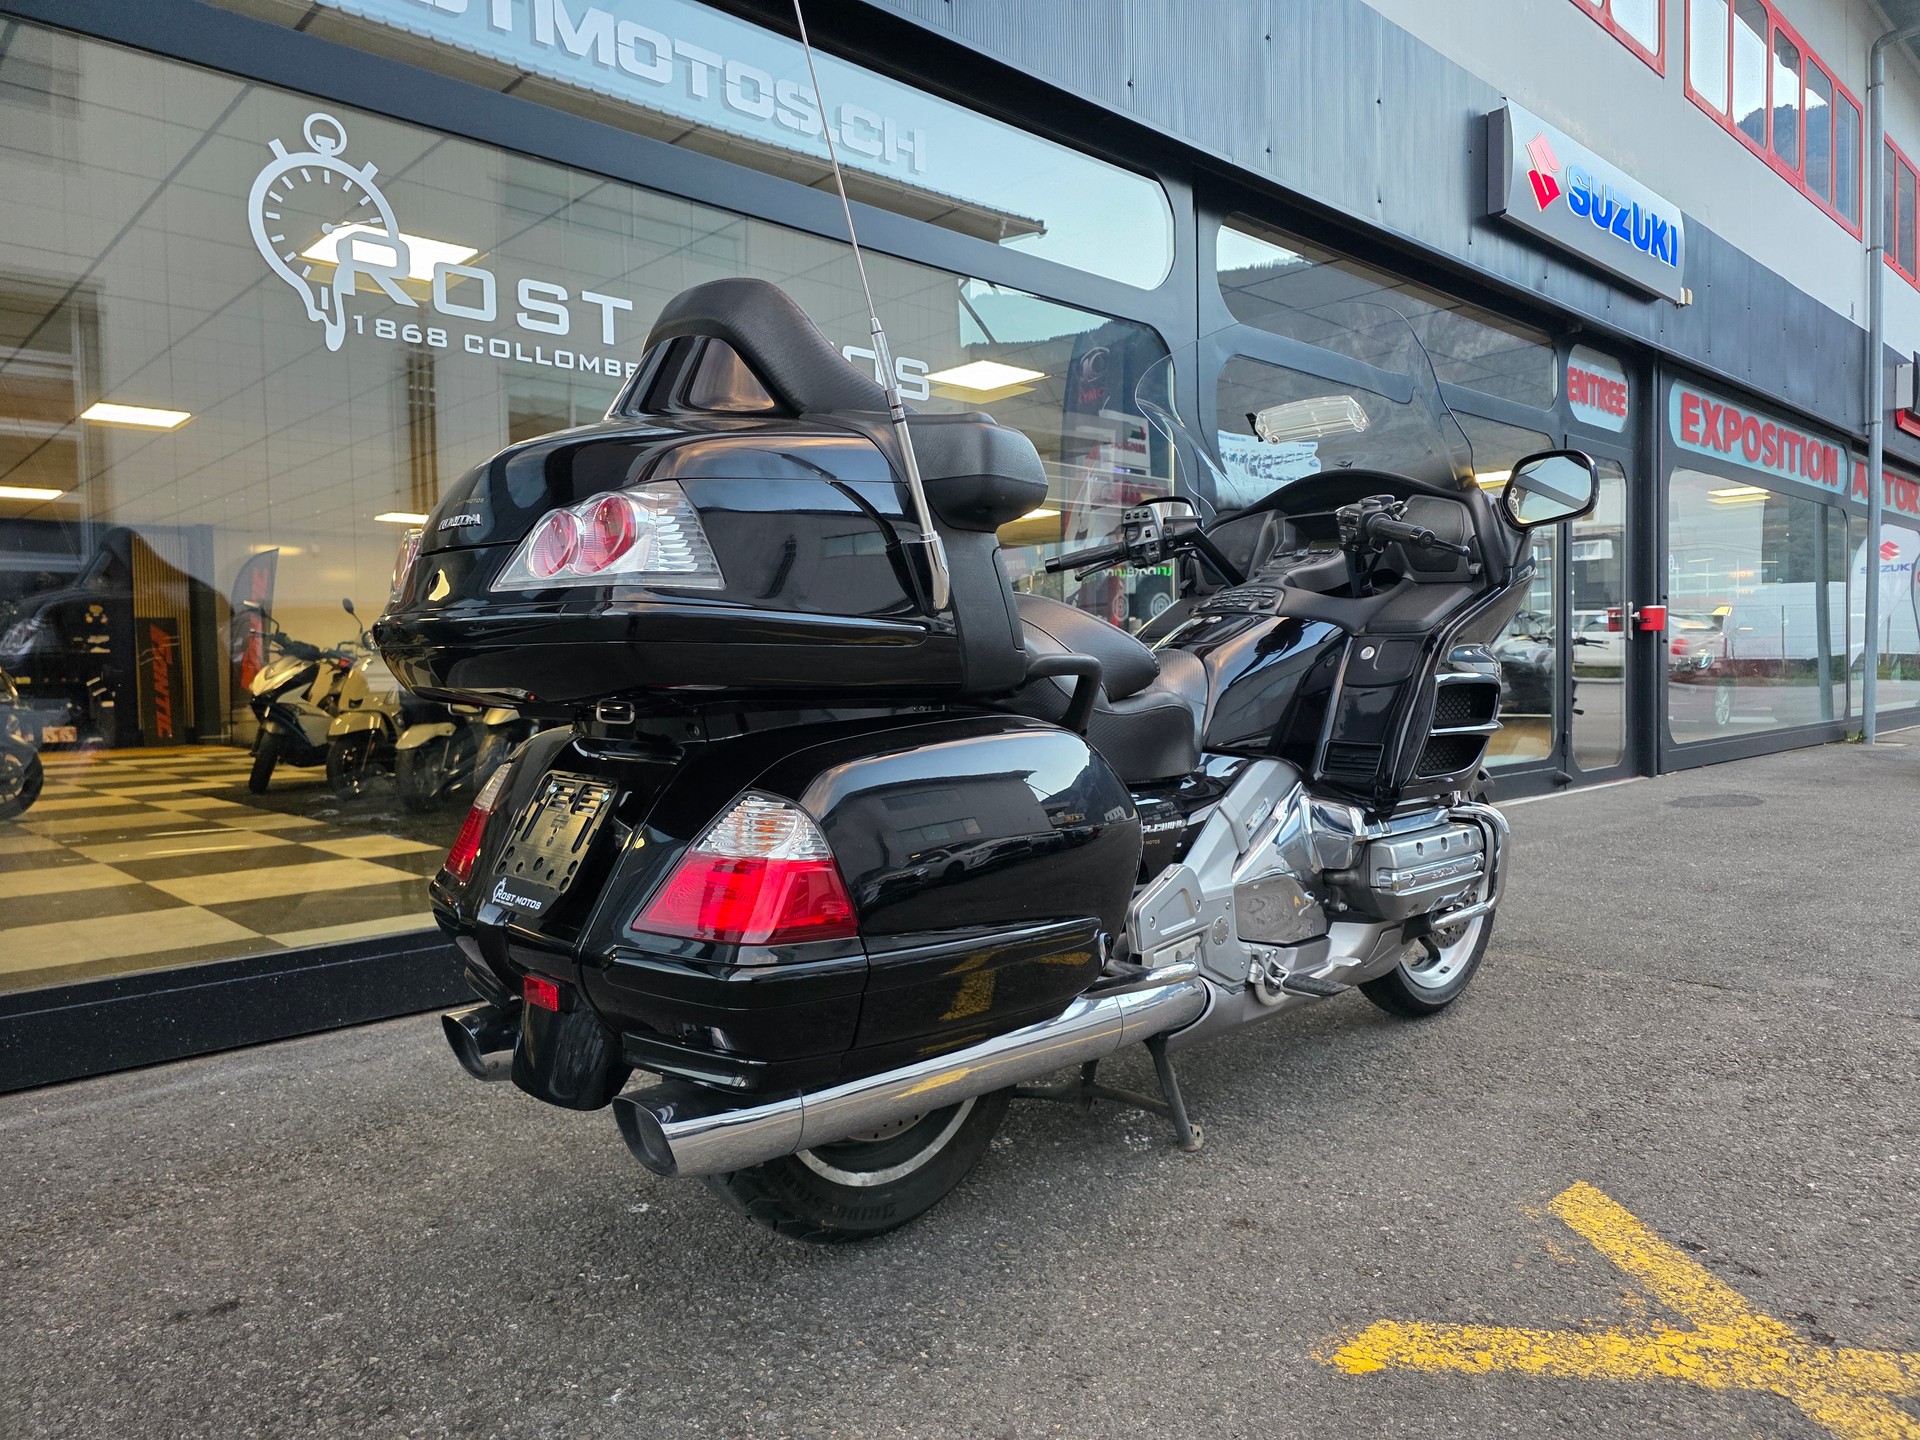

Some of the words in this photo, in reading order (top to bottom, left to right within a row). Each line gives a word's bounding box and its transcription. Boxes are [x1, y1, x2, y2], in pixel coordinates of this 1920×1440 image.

[421, 0, 927, 173] MOTOS.CH
[1566, 164, 1678, 269] SUZUKI
[334, 231, 634, 346] ROST
[353, 314, 448, 349] 1868
[1568, 366, 1626, 417] ENTREE
[1681, 391, 1839, 487] EXPOSITION
[1852, 461, 1920, 515] ATOR
[495, 888, 517, 902] ROST
[515, 895, 543, 910] MOTOS
